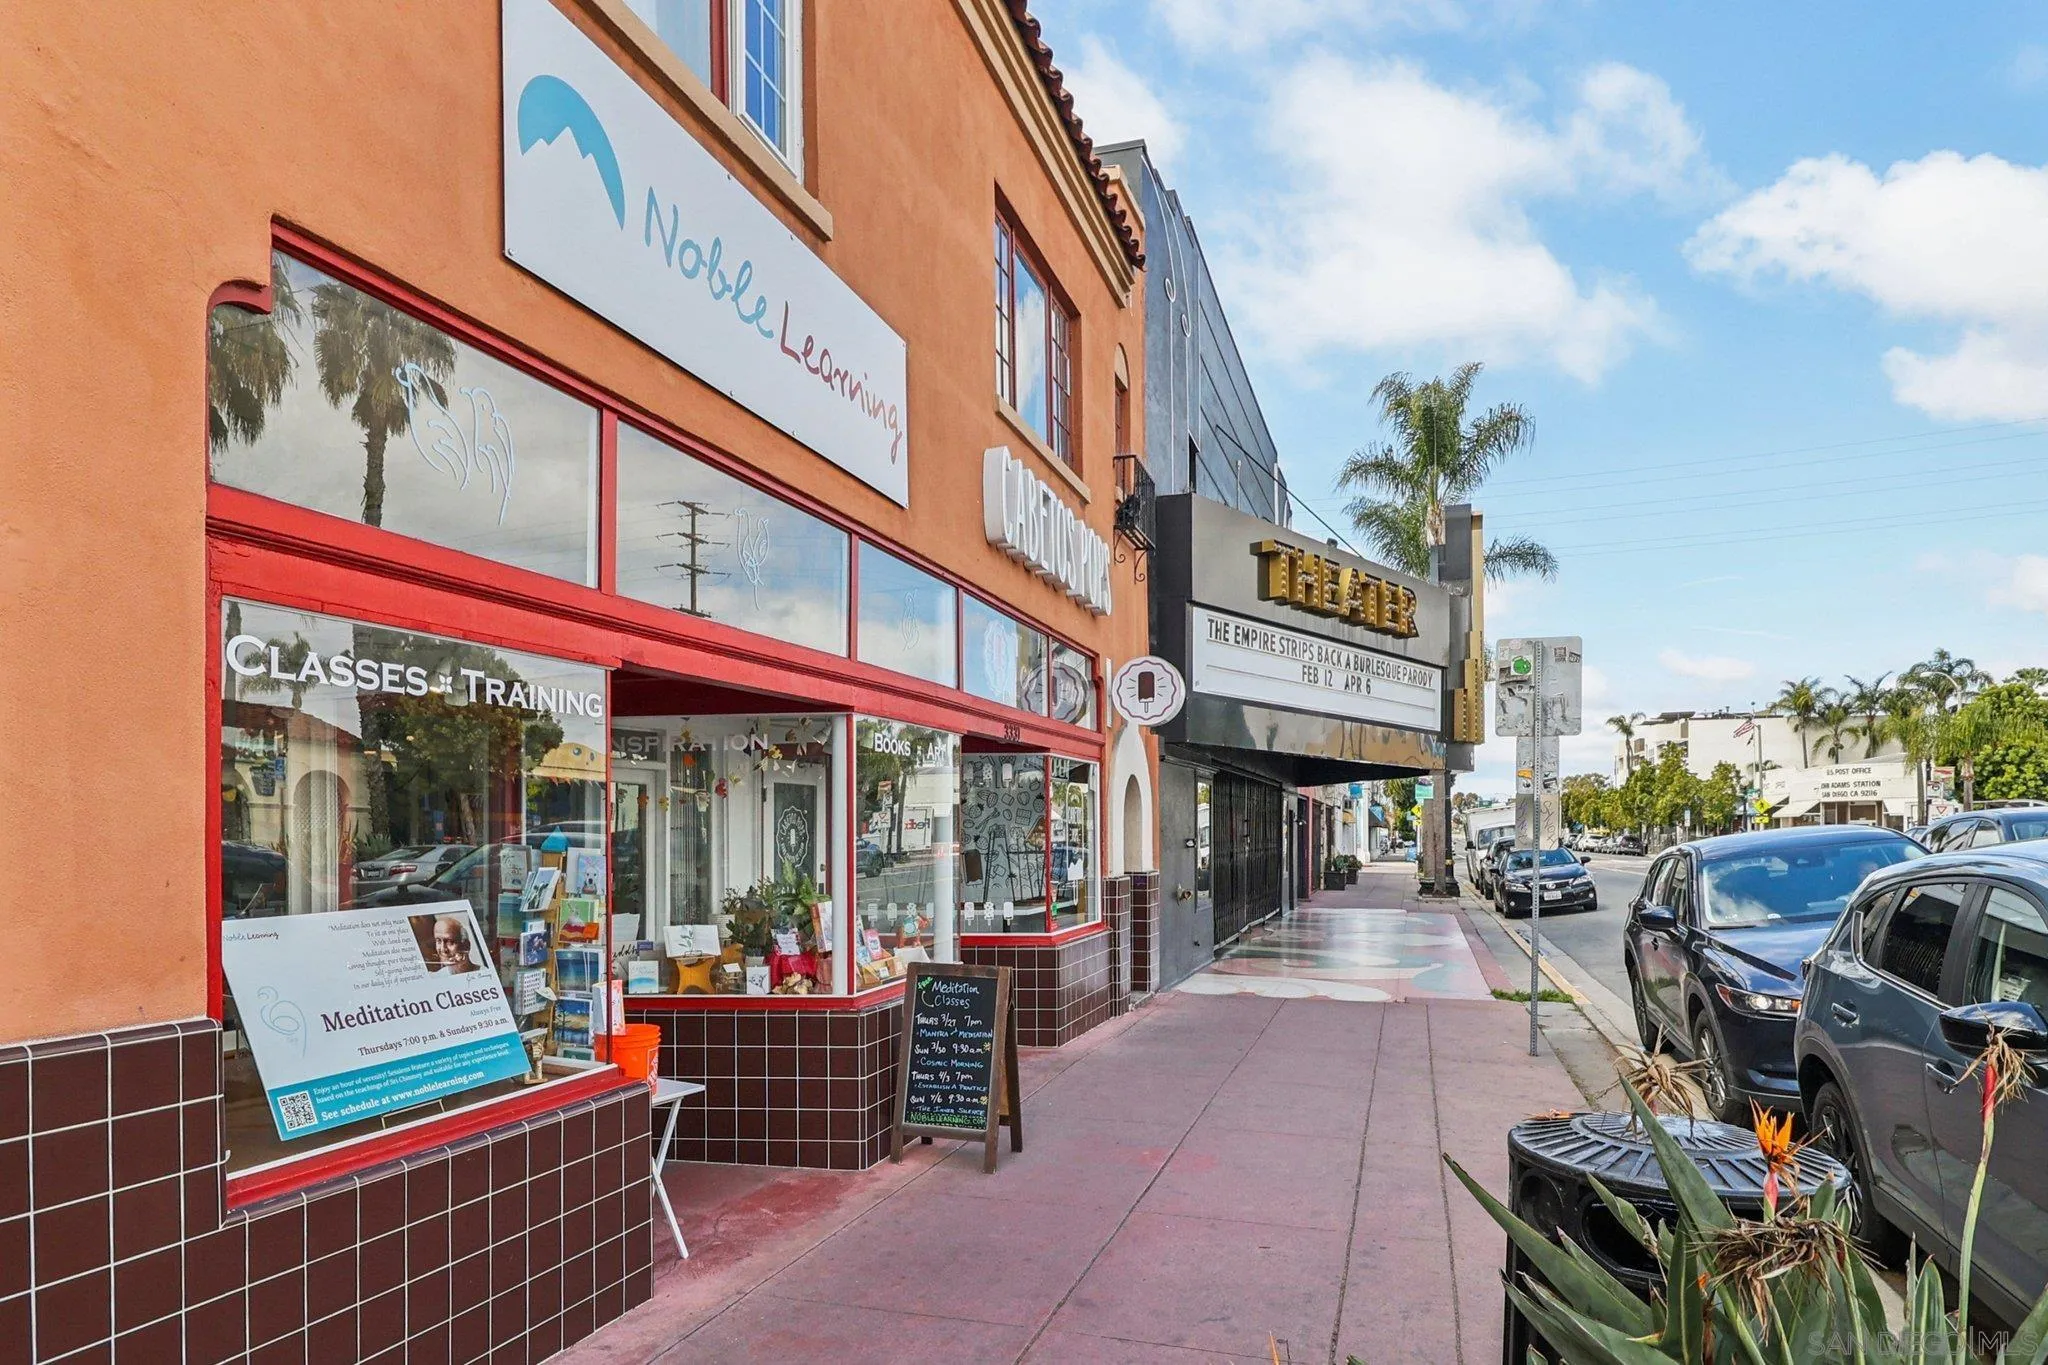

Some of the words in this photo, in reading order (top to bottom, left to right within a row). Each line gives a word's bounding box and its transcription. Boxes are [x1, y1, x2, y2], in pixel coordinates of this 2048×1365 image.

[1250, 538, 1419, 639] THEATER
[1207, 617, 1230, 643] THE
[1234, 624, 1276, 653] EMPIRE
[1279, 636, 1315, 661] STRIPS
[1317, 645, 1343, 668] BACK
[1344, 653, 1352, 670] A
[1353, 654, 1402, 680] BURLESQUE
[1402, 666, 1434, 688] PARODY
[225, 634, 429, 697] CLASSES
[460, 666, 604, 719] TRAINING
[1301, 664, 1319, 684] FEB
[1324, 669, 1333, 688] 12
[1344, 674, 1362, 693] APR
[1365, 678, 1372, 695] 6
[612, 733, 769, 753] NSPIRATION
[874, 732, 911, 757] BOOKS
[1831, 781, 1851, 789] ADAMS
[1853, 780, 1881, 788] STATION
[1860, 789, 1878, 797] 92116
[931, 980, 980, 995] Meditation
[320, 998, 433, 1033] Meditation
[435, 986, 499, 1010] Classes
[934, 994, 971, 1009] Classes
[964, 1015, 983, 1027] 7pm
[357, 1040, 402, 1057] Thursdays
[402, 1035, 421, 1047] 7:00
[421, 1034, 438, 1045] p.m.
[439, 1030, 445, 1038] &
[446, 1024, 478, 1038] Sundays
[477, 1019, 493, 1030] 9:30
[494, 1016, 509, 1027] a.m.
[931, 1040, 946, 1053] 3/30
[938, 1070, 951, 1083] 4/3
[955, 1071, 974, 1082] 7pm
[313, 1086, 331, 1096] Enjoy
[340, 1080, 355, 1089] hour
[321, 1110, 340, 1121] See
[340, 1097, 380, 1117] schedule
[381, 1094, 391, 1105] at
[391, 1070, 485, 1103] www.noblelearning.com
[344, 1089, 355, 1097] the
[930, 1091, 943, 1104] 4/6
